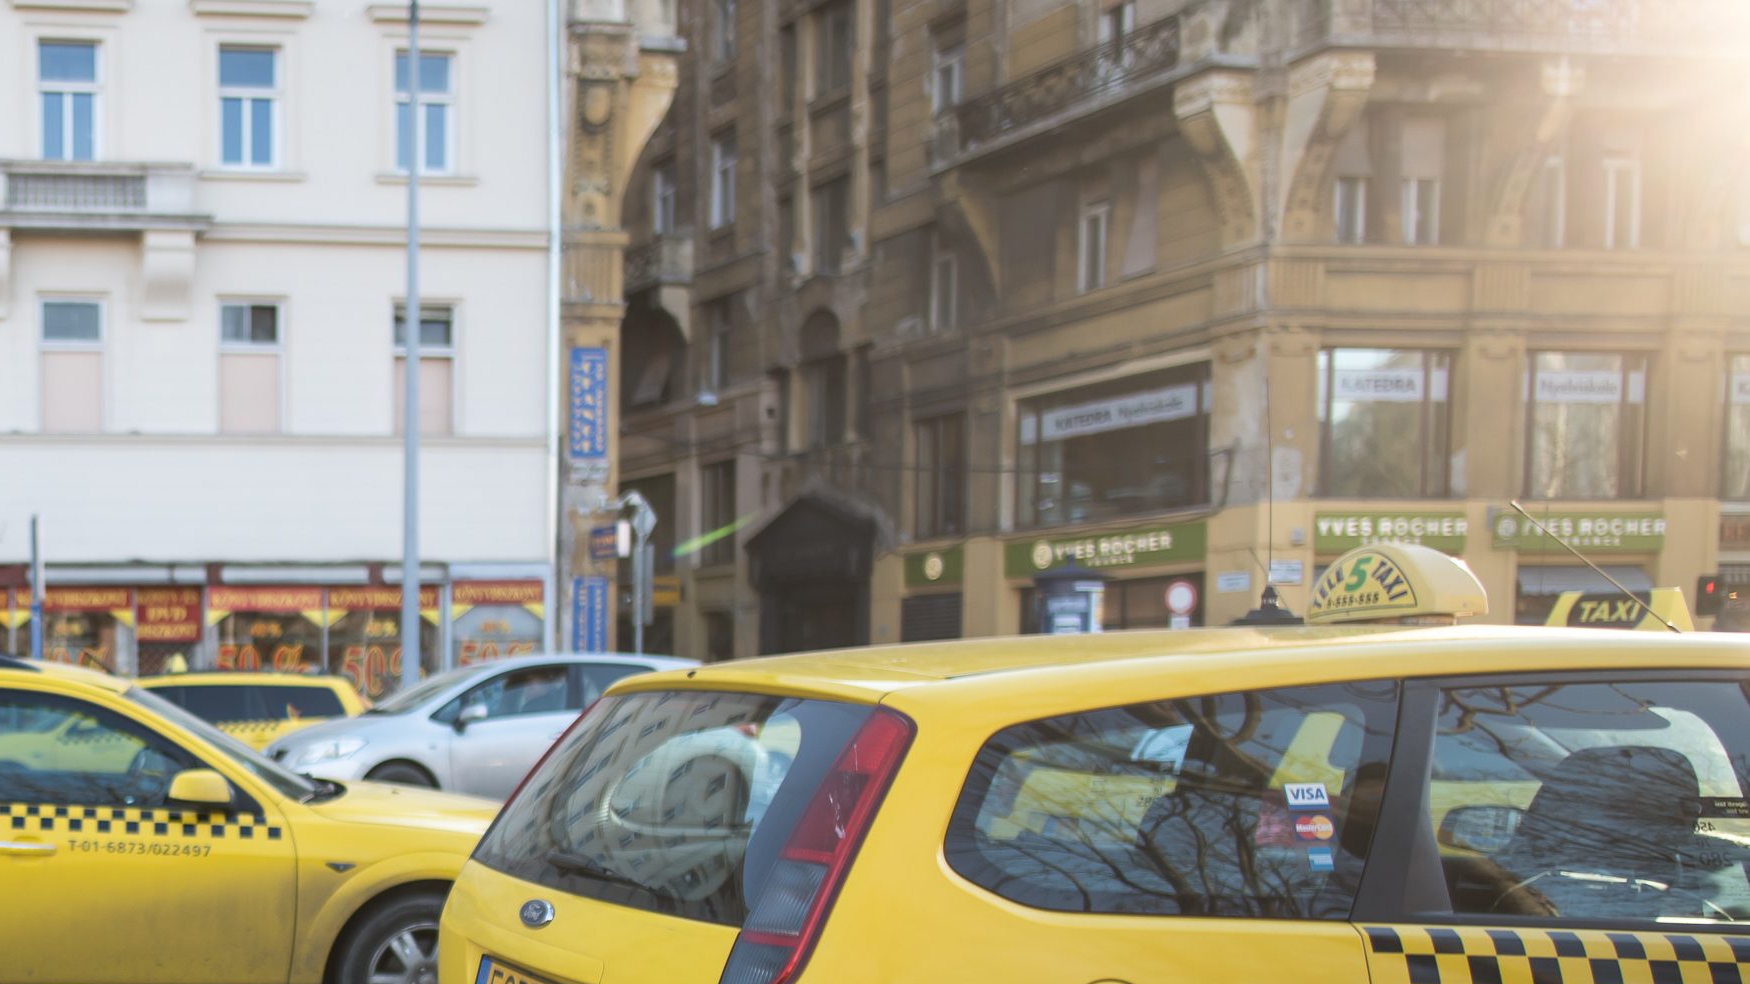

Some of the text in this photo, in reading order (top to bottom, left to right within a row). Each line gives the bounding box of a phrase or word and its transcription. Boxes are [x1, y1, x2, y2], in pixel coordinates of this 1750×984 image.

[1317, 516, 1468, 537] YVES ROCHER
[1578, 517, 1667, 537] ROCHER
[1100, 531, 1172, 556] ROCHER
[1579, 600, 1643, 624] TAXI
[1290, 788, 1326, 800] VISA
